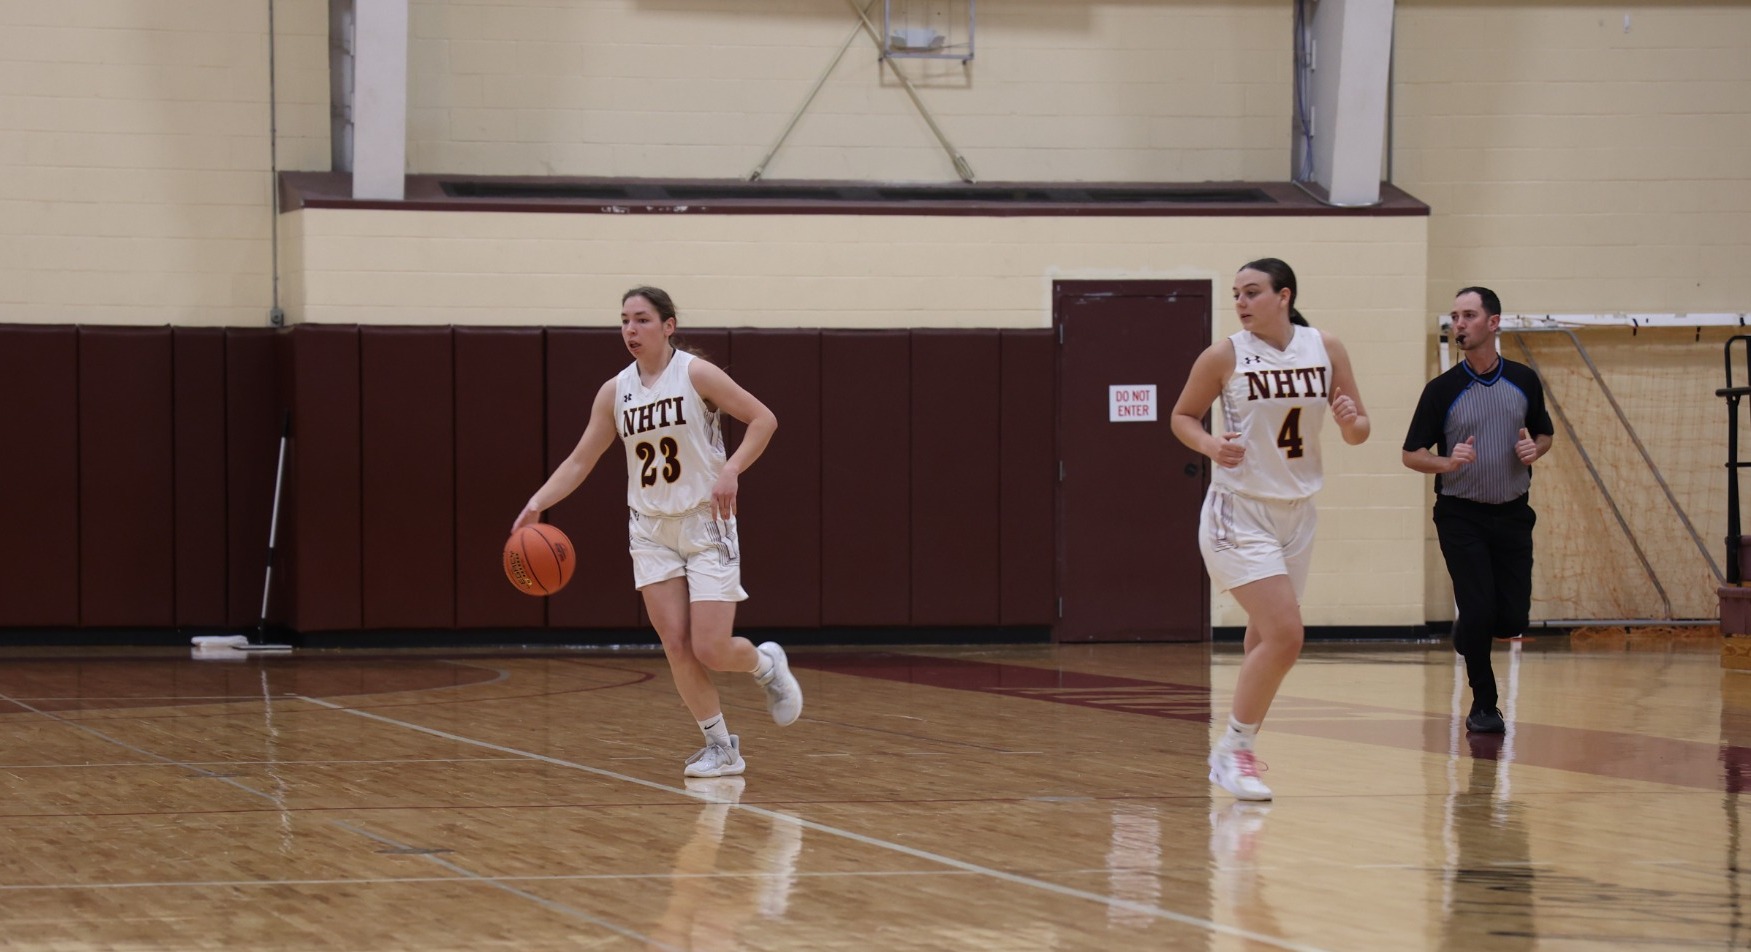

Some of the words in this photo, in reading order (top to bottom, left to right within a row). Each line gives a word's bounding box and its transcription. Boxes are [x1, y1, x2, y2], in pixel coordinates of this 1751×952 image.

[1116, 390, 1130, 402] DO
[1132, 390, 1150, 401] NOT
[1244, 367, 1327, 401] NHTI
[623, 396, 687, 438] NHTI
[1118, 405, 1149, 416] ENTER
[1277, 406, 1303, 459] 4
[636, 436, 681, 488] 23
